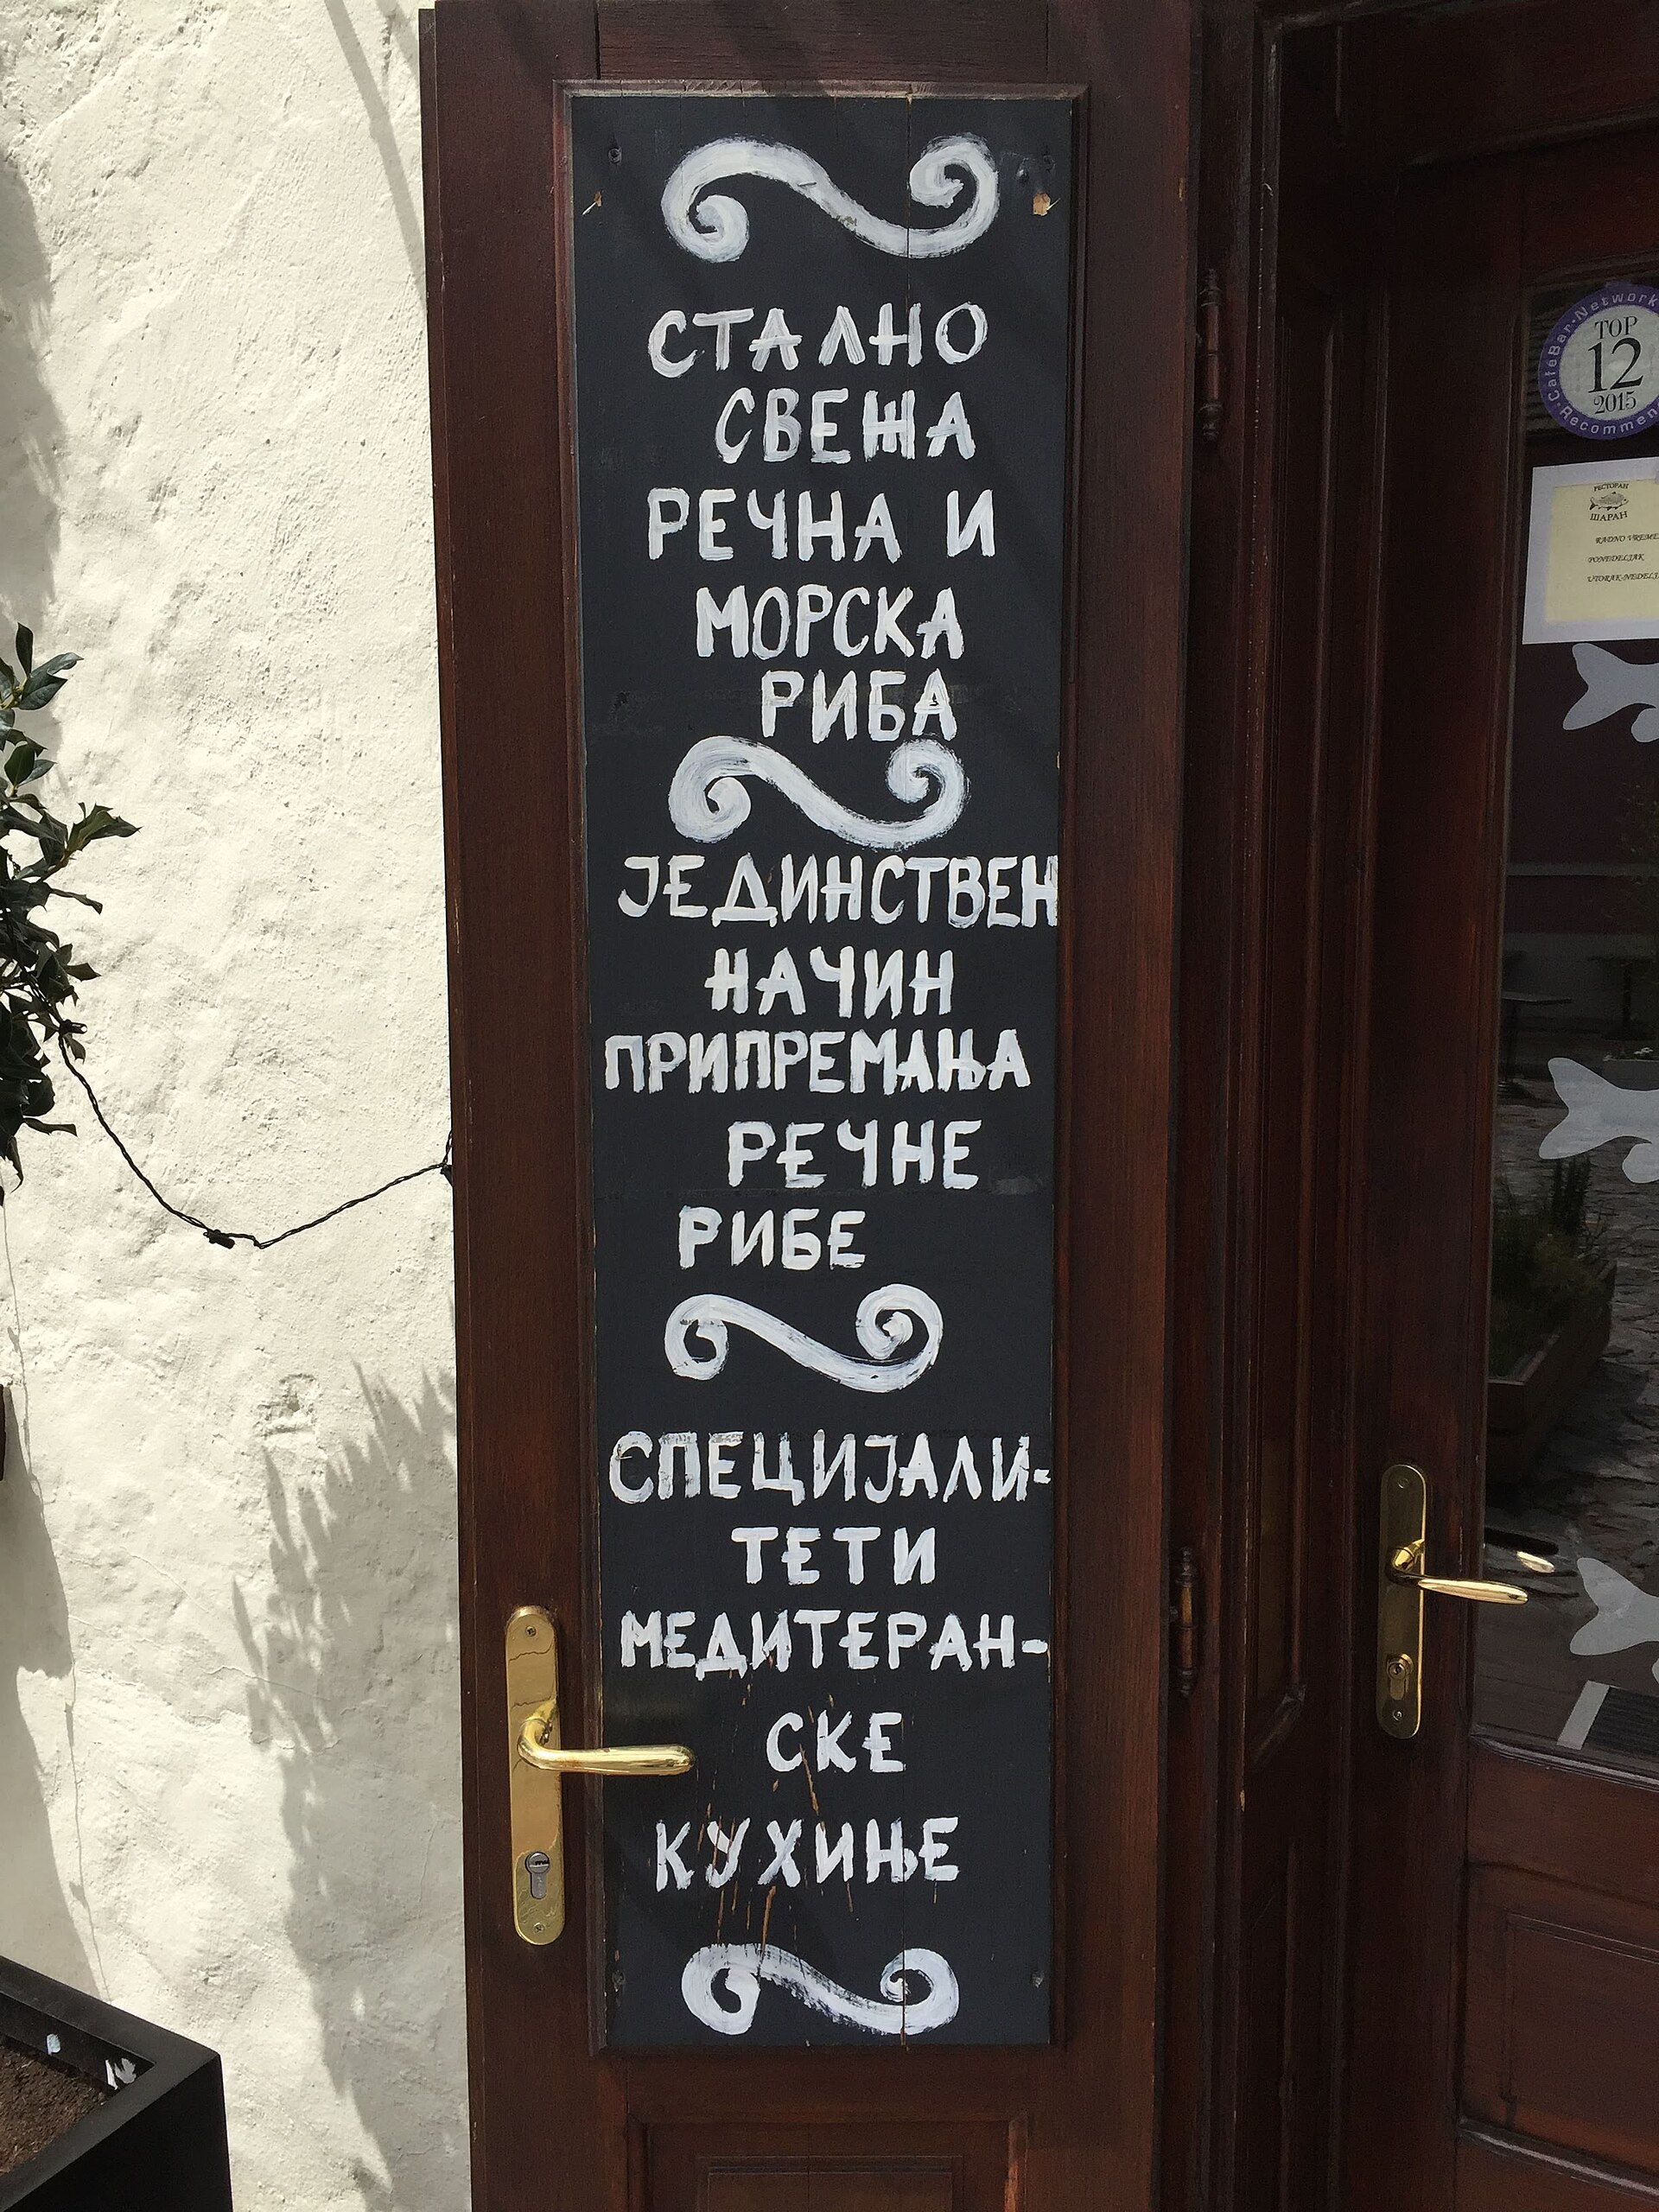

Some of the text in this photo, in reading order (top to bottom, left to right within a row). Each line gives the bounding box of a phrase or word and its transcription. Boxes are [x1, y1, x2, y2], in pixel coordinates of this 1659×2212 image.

[648, 302, 988, 378] СТАЛНО
[1594, 315, 1638, 340] TOP
[1587, 337, 1643, 393] 12
[1559, 399, 1659, 435] Recommen
[1593, 391, 1637, 415] 2015
[1589, 511, 1629, 522] ШАРАН
[1593, 482, 1630, 492] РЕСТОРАН
[648, 487, 995, 563] РЕЧНА И
[1587, 553, 1645, 563] PONEDELJAK
[1595, 534, 1626, 544] RADNO
[696, 584, 964, 660] МОРСКА
[761, 669, 957, 743] РИБА
[618, 853, 1058, 928] ЈЕДИНСТВЕН
[704, 945, 954, 1019] НАЧИН
[605, 1028, 1032, 1096] ПРИПРЕМАЊА
[728, 1119, 982, 1190] РЕЧНЕ
[678, 1205, 866, 1270] РИБЕ
[608, 1429, 1052, 1506] СПЕЦИЈАЛИ-
[731, 1527, 936, 1585] ТЕТИ
[620, 1609, 1048, 1681] МЕДИТЕРАН-
[766, 1710, 906, 1772] СКЕ
[655, 1816, 960, 1891] КУХИЊЕ
